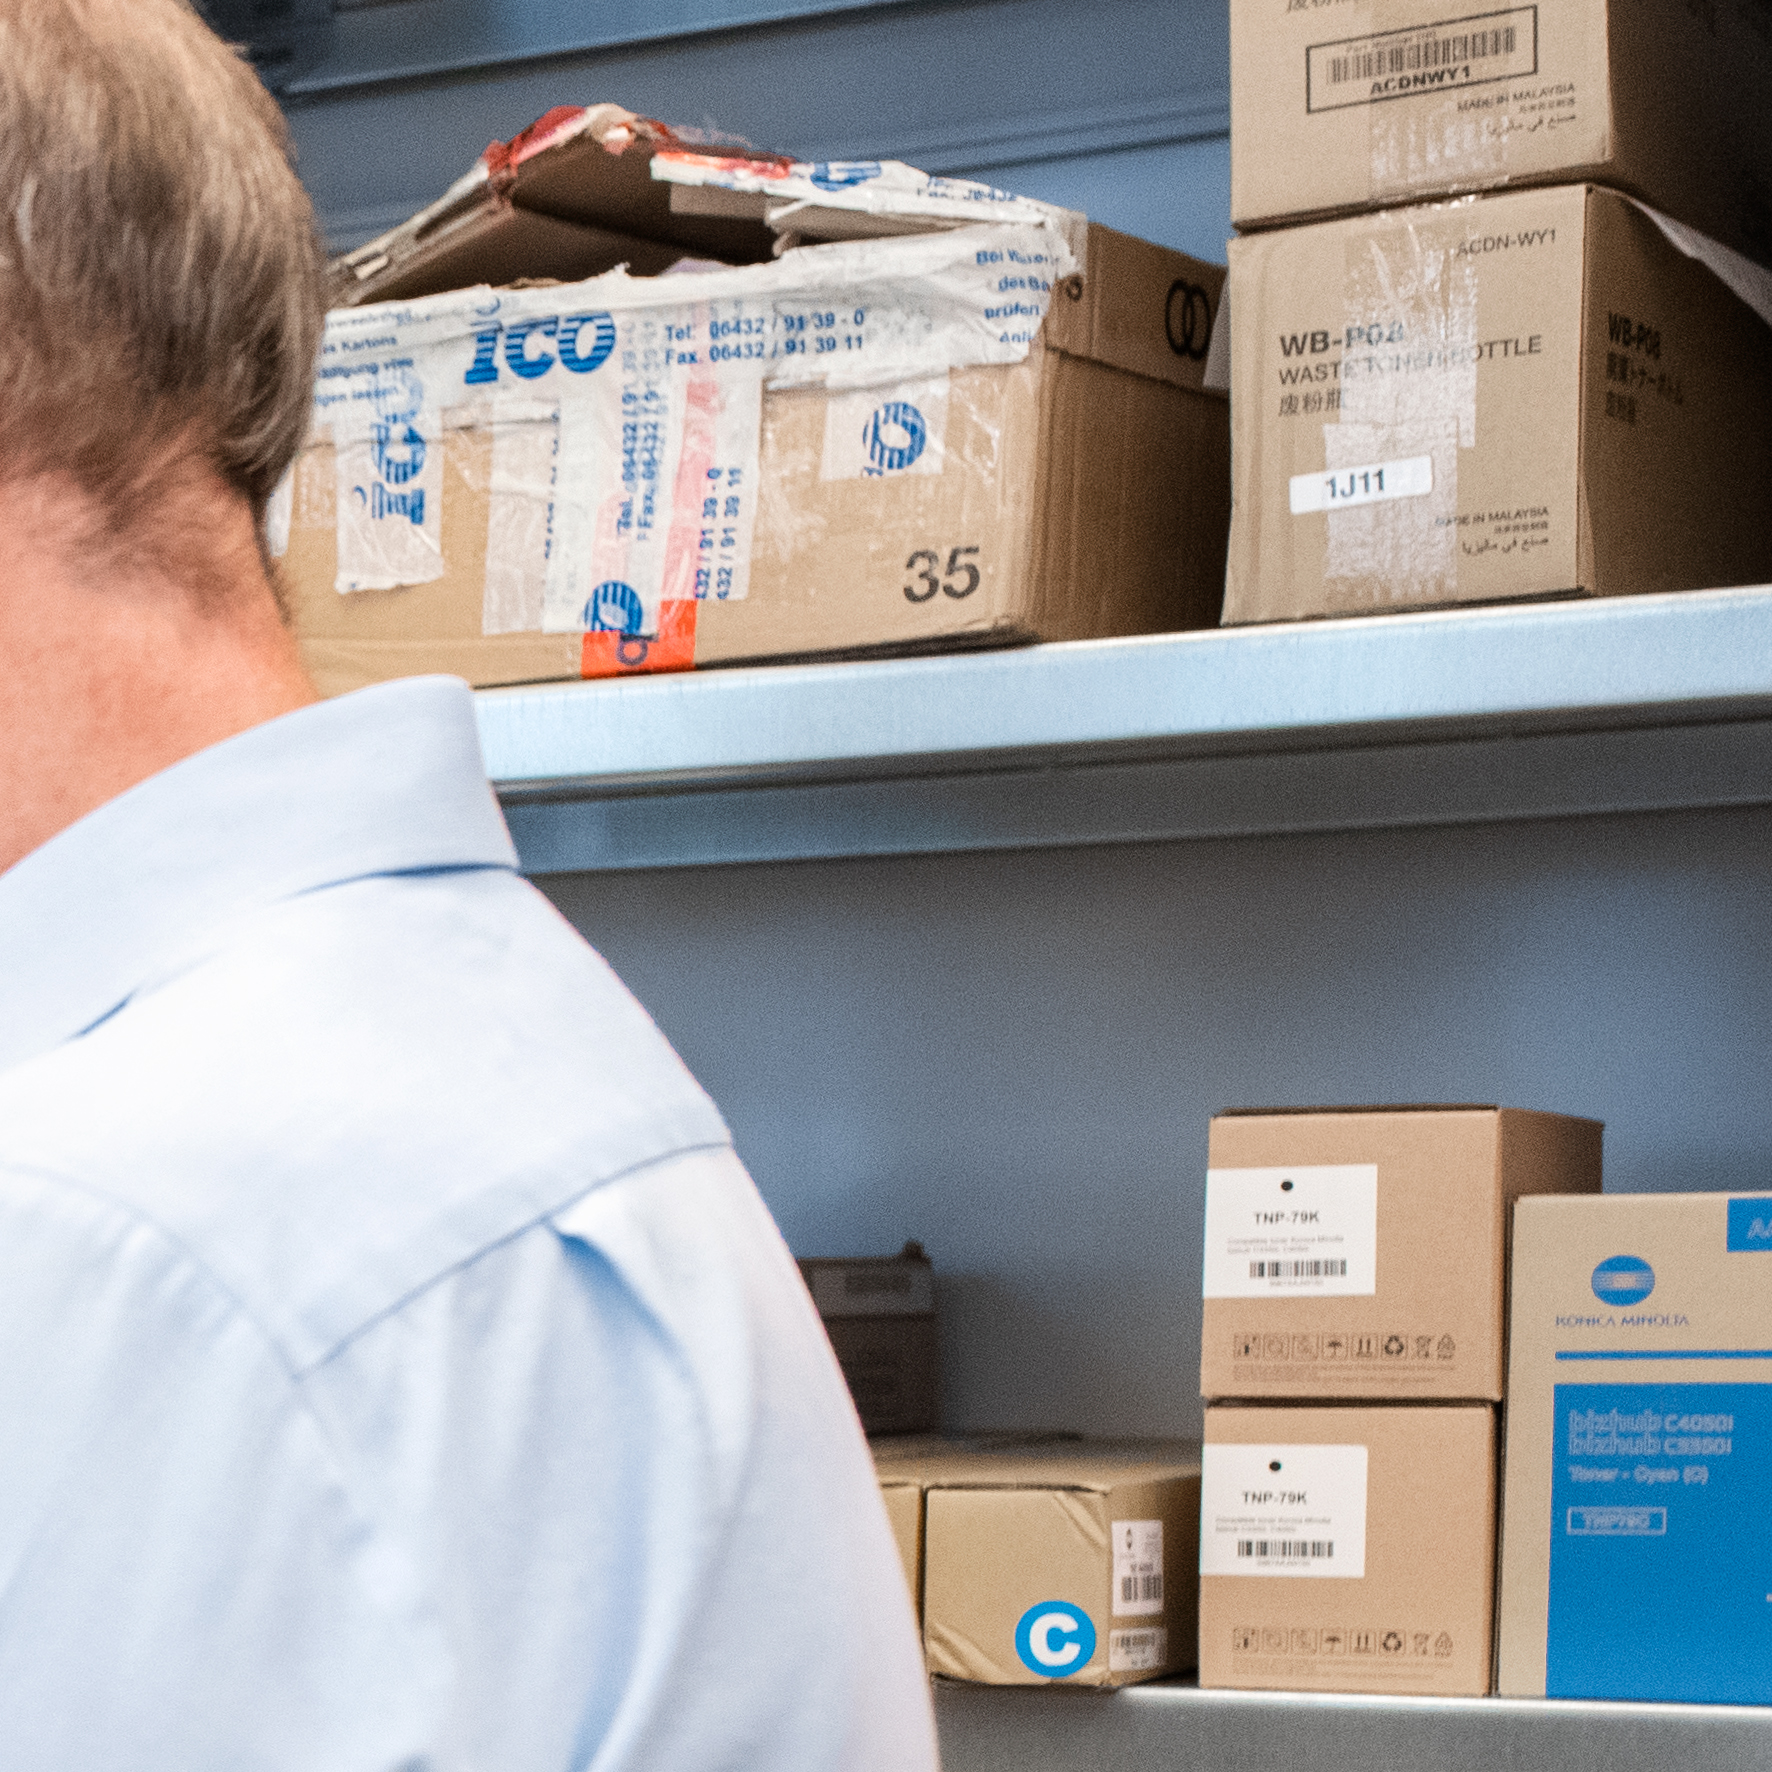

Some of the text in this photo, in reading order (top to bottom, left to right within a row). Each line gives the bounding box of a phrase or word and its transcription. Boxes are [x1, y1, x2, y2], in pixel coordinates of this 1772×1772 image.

[1370, 65, 1471, 95] ACDNWY1
[1456, 229, 1556, 257] ACDN-WY1
[1325, 467, 1385, 500] 1J11
[1488, 507, 1549, 523] MALAYSIA
[903, 546, 981, 604] 35
[1254, 1209, 1320, 1225] TNP-79K
[1556, 1313, 1689, 1328] KONICA MINOLTA
[1242, 1490, 1307, 1505] TNP-79K
[1029, 1612, 1081, 1667] C
